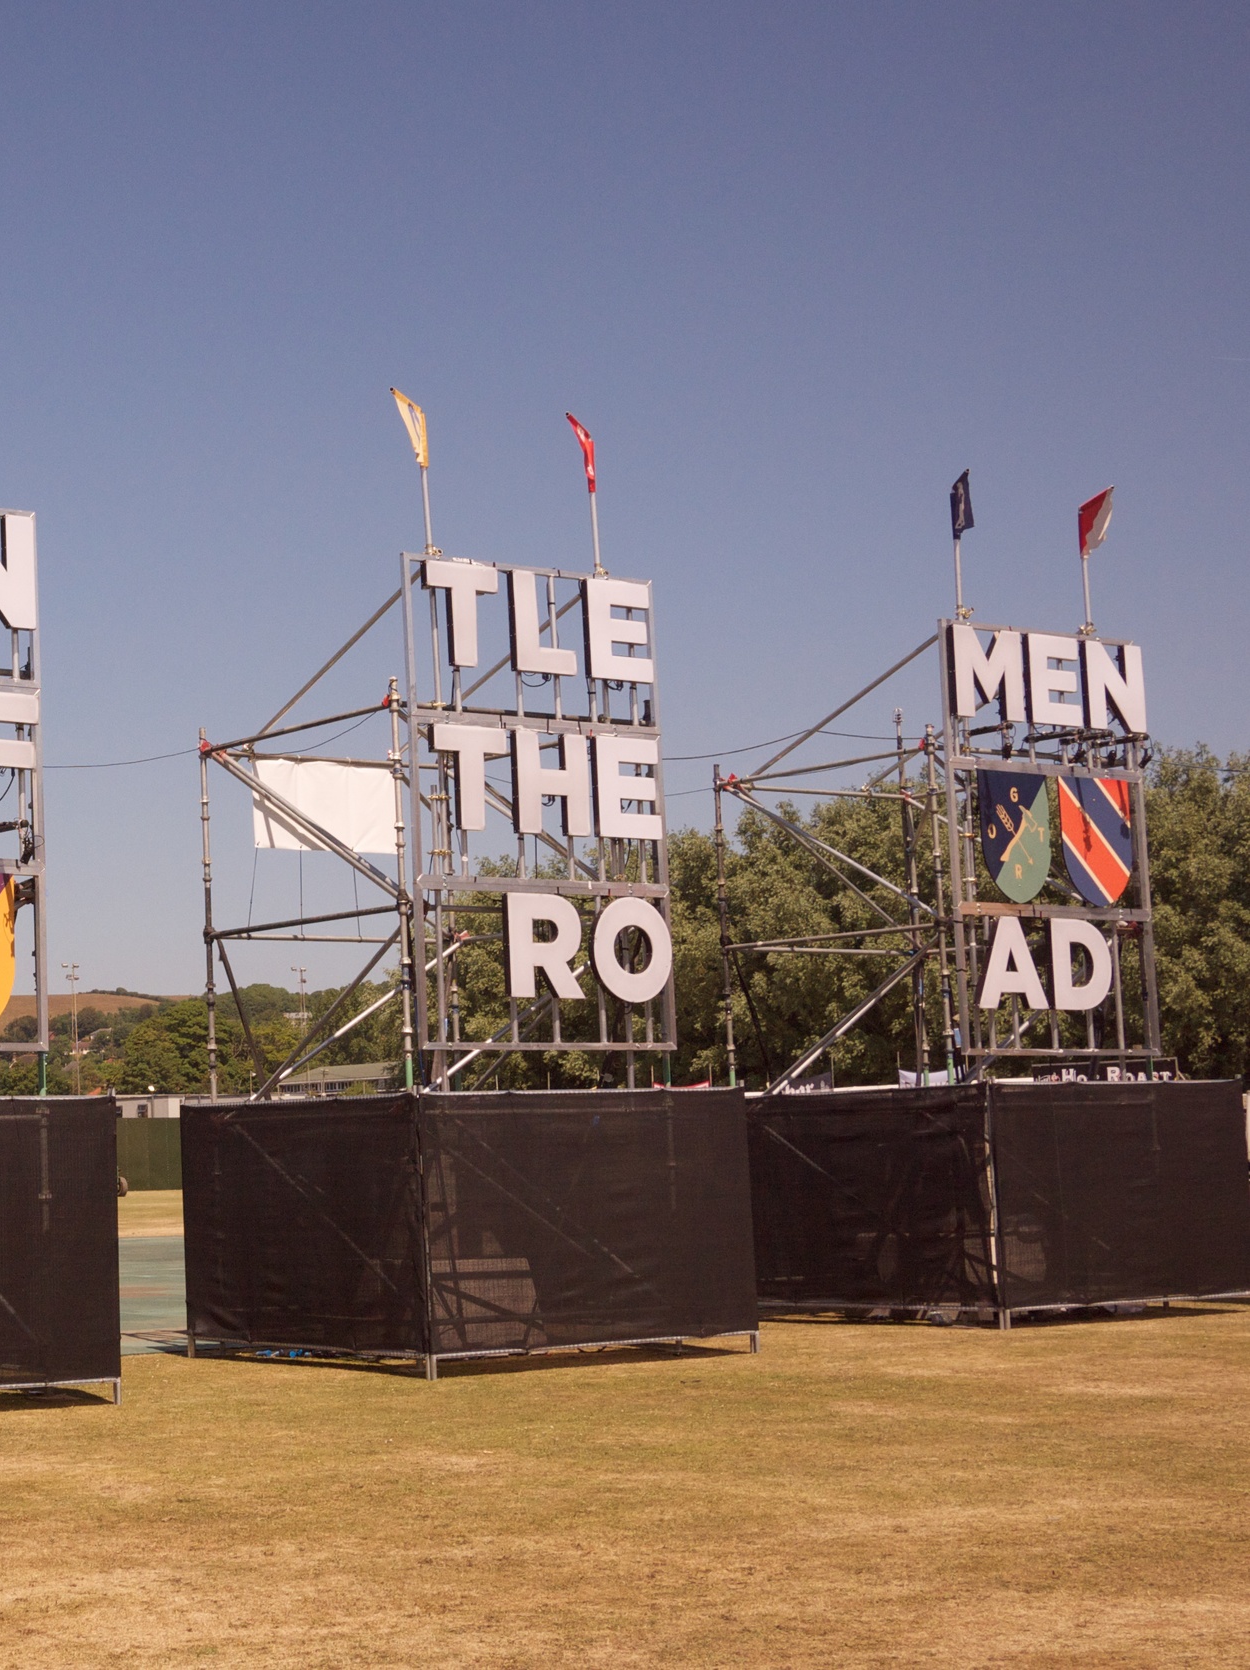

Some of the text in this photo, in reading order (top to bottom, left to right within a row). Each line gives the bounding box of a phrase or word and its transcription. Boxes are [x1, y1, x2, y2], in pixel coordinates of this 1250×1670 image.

[421, 559, 654, 684] TLE
[950, 624, 1148, 735] MEN
[428, 723, 662, 841] THE
[1009, 787, 1019, 803] G
[502, 892, 672, 1003] RO
[976, 915, 1113, 1011] AD
